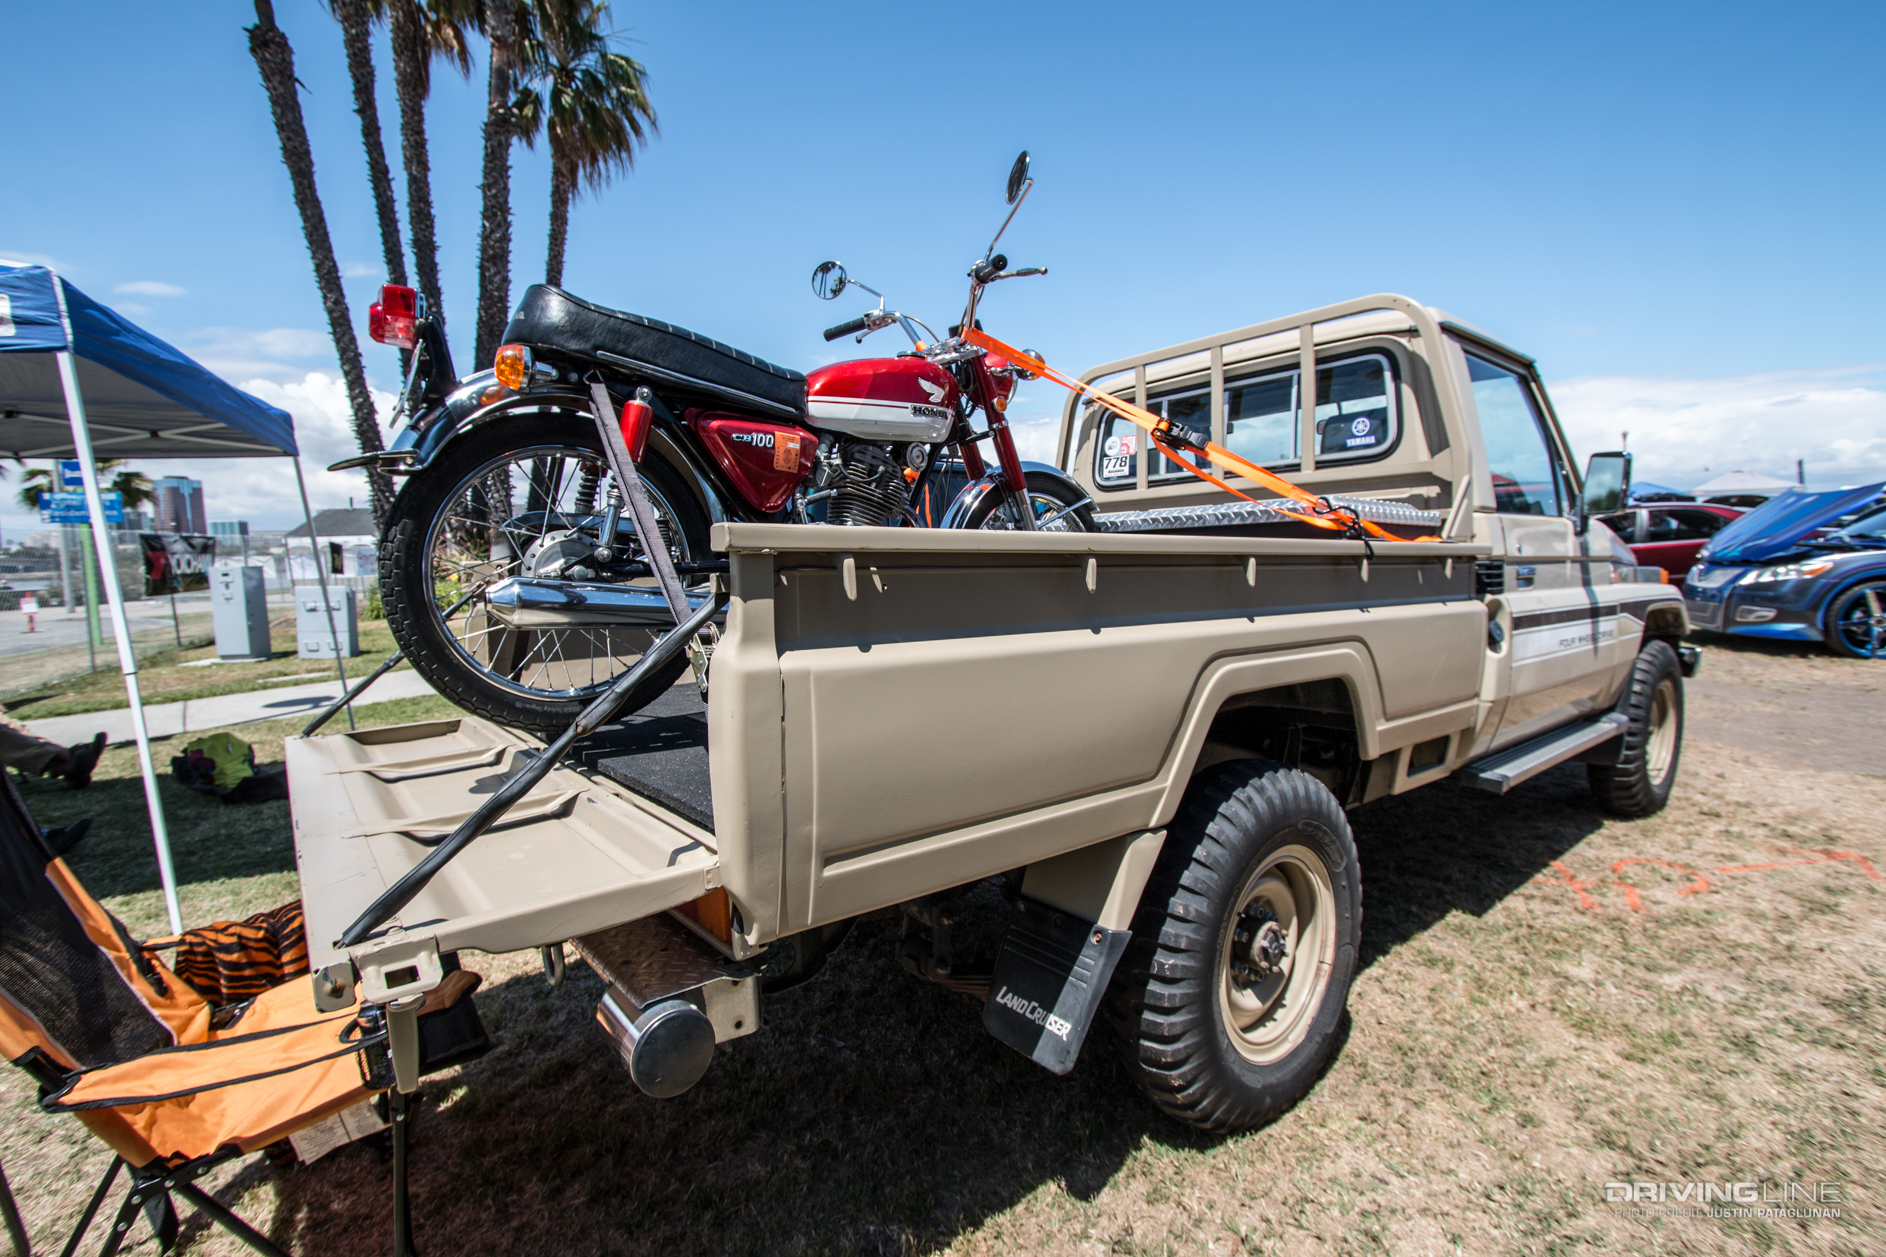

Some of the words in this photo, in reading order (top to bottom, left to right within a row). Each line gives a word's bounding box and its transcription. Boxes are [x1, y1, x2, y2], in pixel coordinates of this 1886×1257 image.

[912, 405, 949, 420] HONDA
[1346, 435, 1376, 448] YAMAHA
[1104, 456, 1128, 470] 778
[1559, 637, 1577, 648] FOUR
